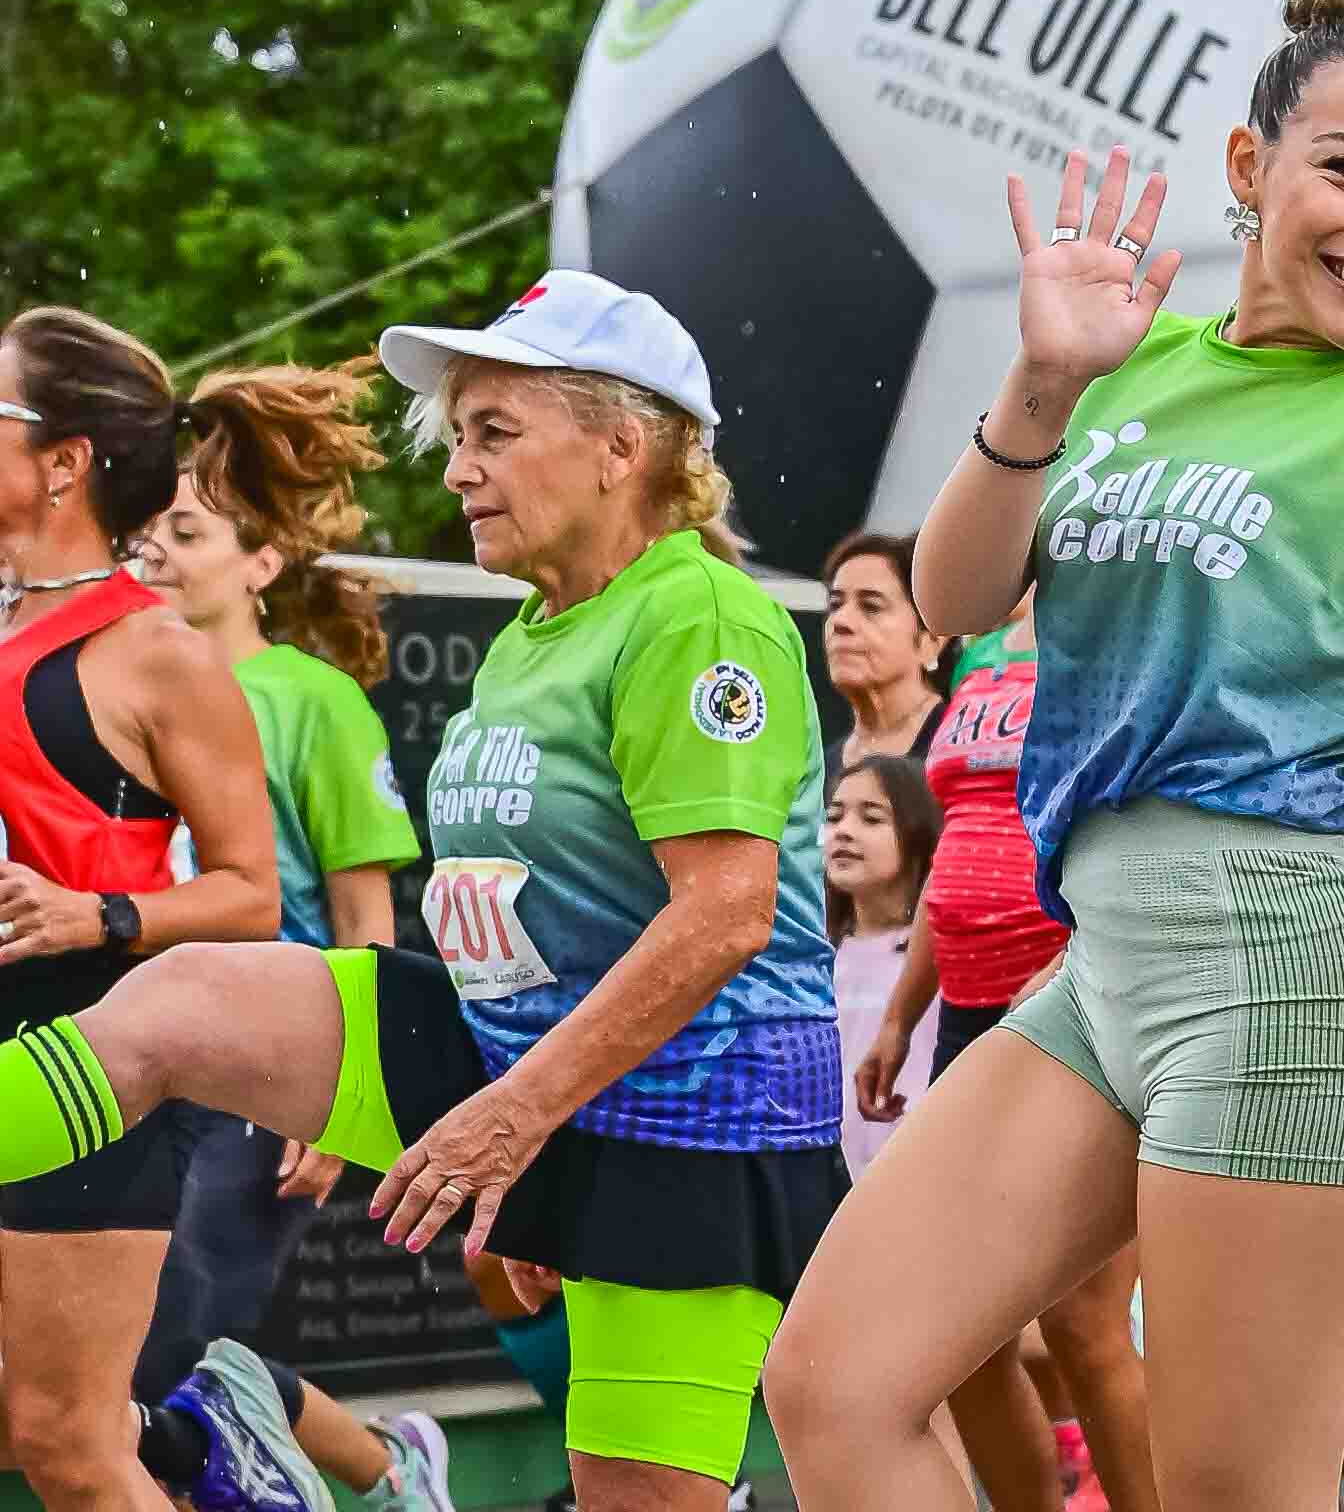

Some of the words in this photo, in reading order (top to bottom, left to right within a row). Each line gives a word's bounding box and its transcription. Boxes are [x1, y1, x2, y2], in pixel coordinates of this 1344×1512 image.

[856, 35, 948, 85] CAPITAL
[959, 67, 1085, 140] NACIONAL
[875, 81, 967, 131] PELOTA
[969, 114, 1009, 146] DE
[1163, 463, 1273, 540] Ville
[1048, 517, 1248, 580] corre
[475, 726, 541, 785] Ville
[431, 786, 533, 826] corre
[430, 871, 514, 962] 201
